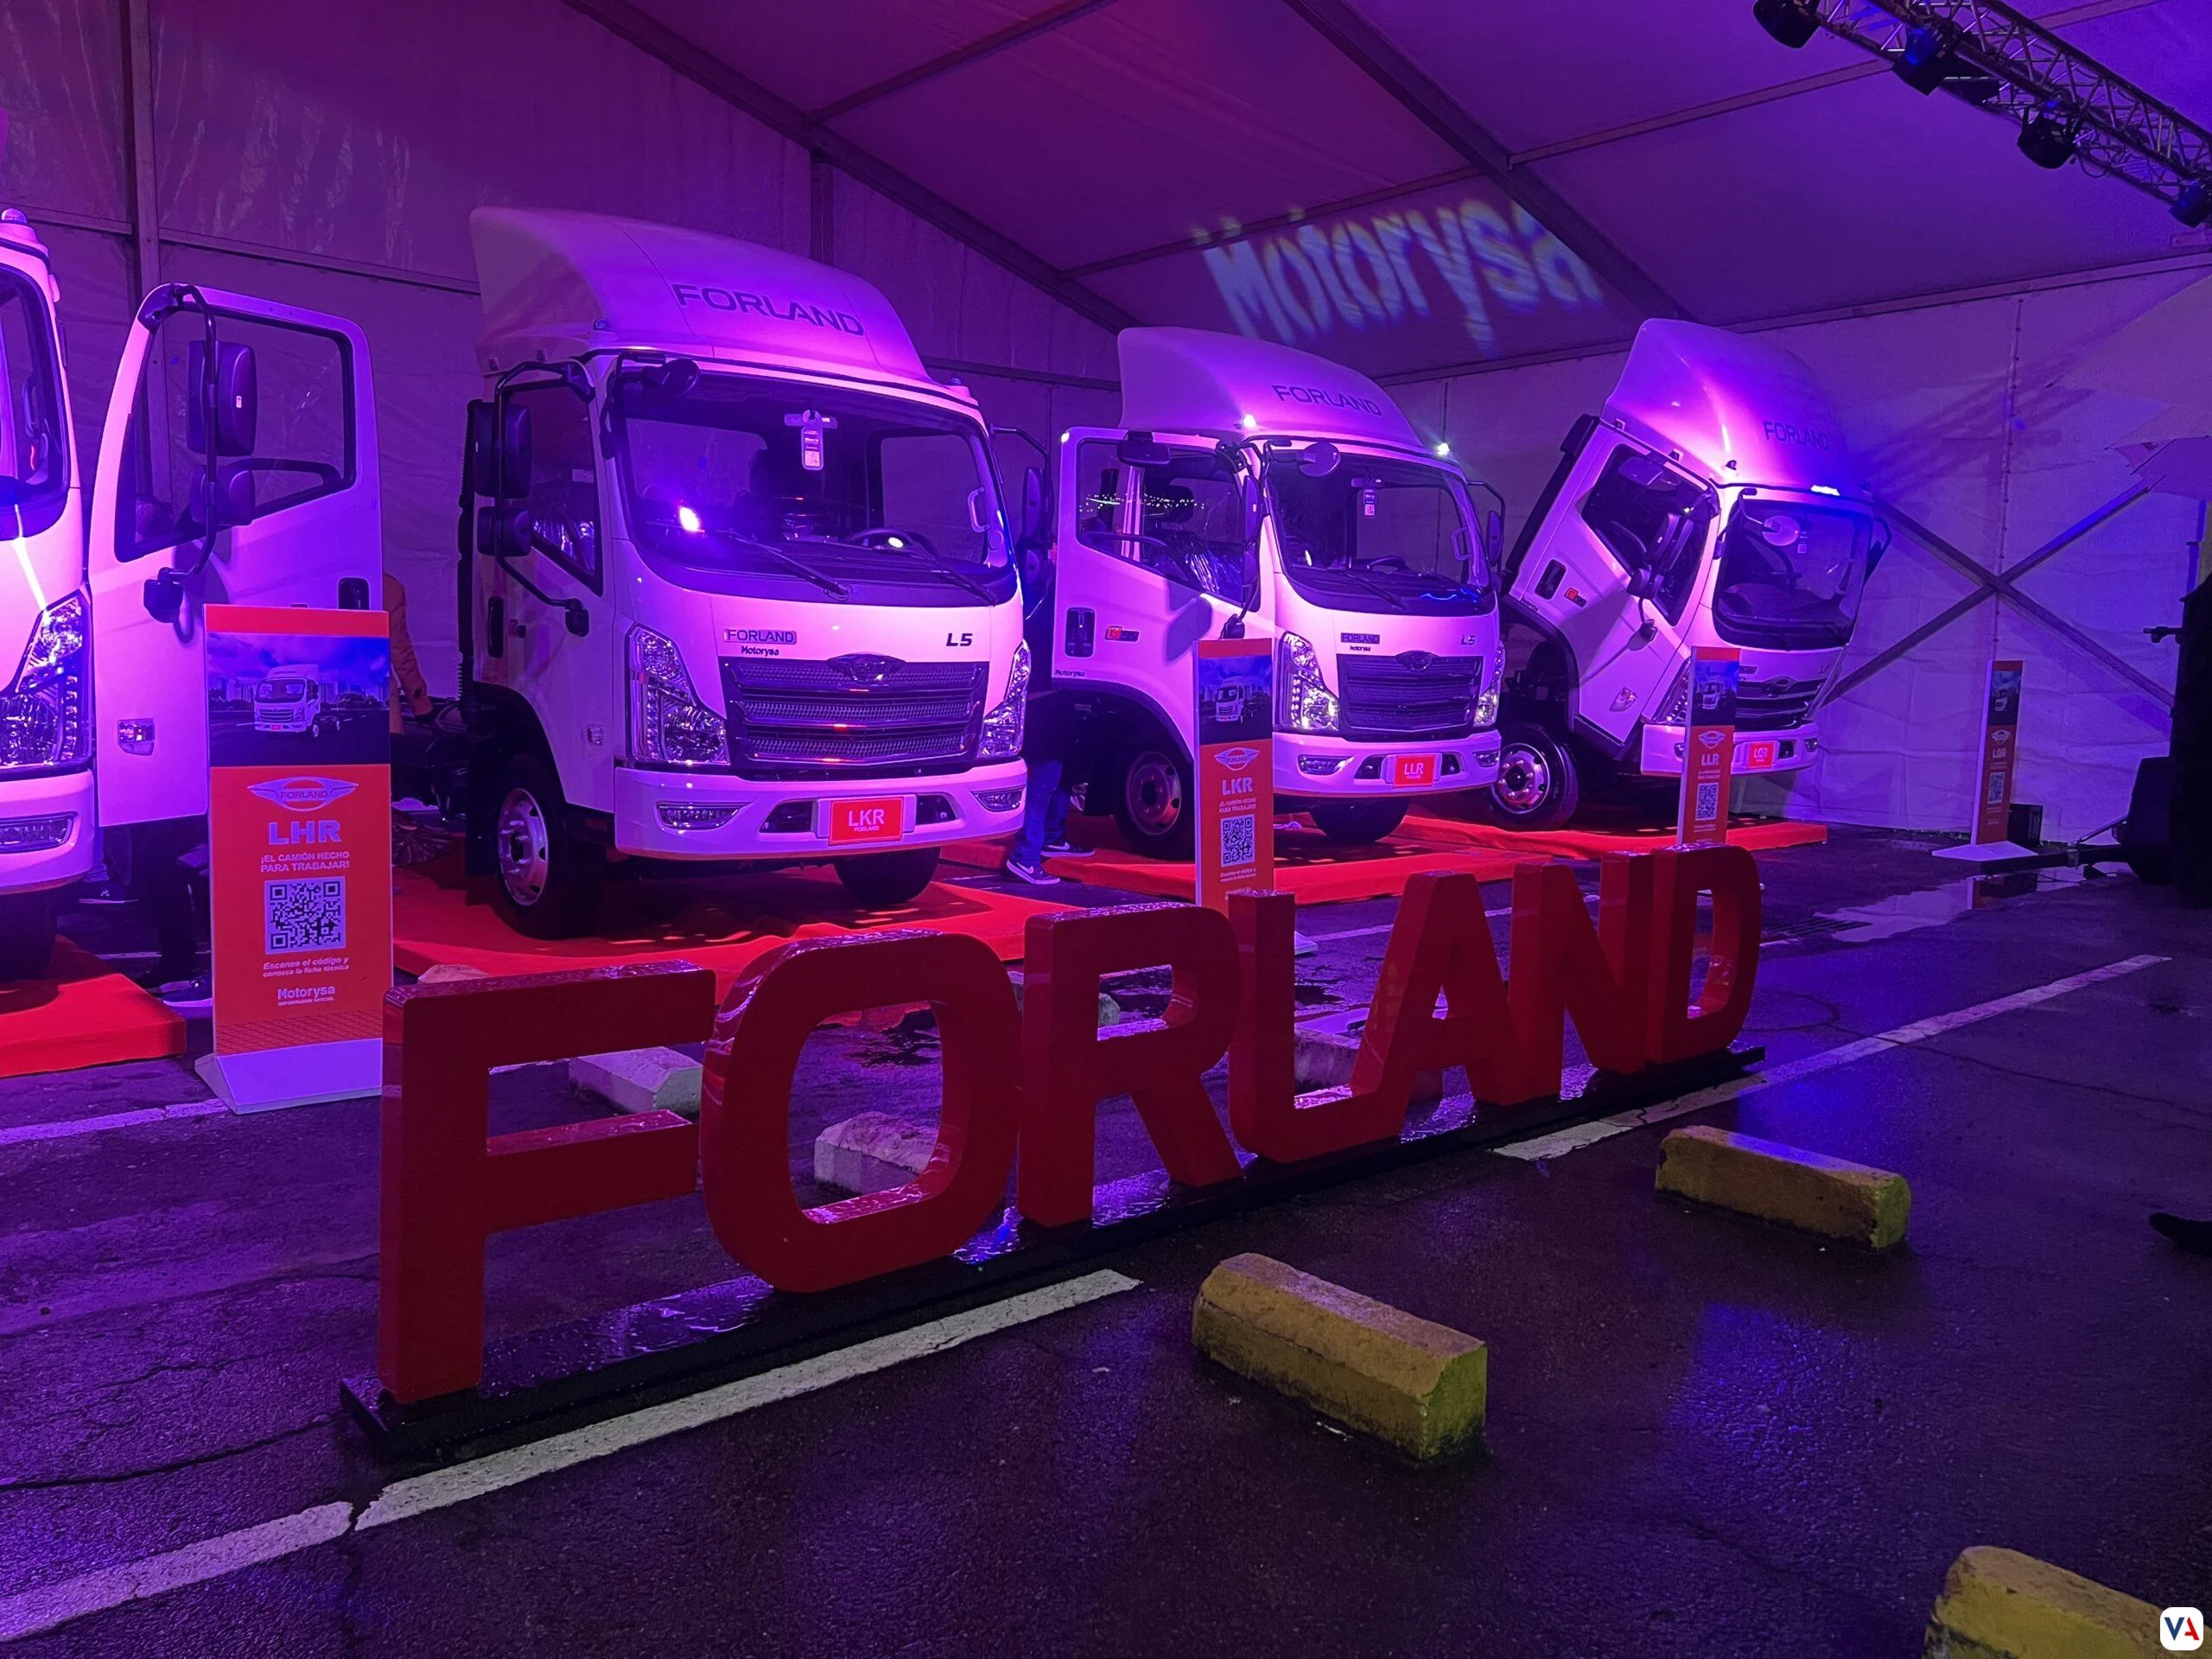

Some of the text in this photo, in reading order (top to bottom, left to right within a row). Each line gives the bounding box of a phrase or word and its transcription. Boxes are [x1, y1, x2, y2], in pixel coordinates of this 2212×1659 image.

[1192, 200, 1605, 358] Motorysa
[671, 283, 864, 336] FORLAND
[1272, 385, 1382, 416] FORLAND
[1764, 422, 1829, 450] FORLAND
[728, 629, 794, 644] FORLAND
[946, 632, 973, 647] L5
[1342, 633, 1380, 644] FORLAND
[1461, 635, 1476, 645] L5
[741, 645, 779, 656] Motorysa
[1701, 753, 1719, 766] LLR
[1404, 762, 1424, 775] LLR
[1223, 777, 1253, 795] LKR
[280, 790, 327, 799] FORLAND
[848, 809, 885, 827] LKR
[269, 819, 342, 845] LHR
[278, 851, 315, 862] CAMIÓN
[317, 850, 350, 860] HECHO
[261, 861, 350, 873] PARA TRABAJAR!
[312, 957, 341, 965] código
[277, 985, 335, 1000] Motorysa
[378, 844, 1761, 1402] FORLAND
